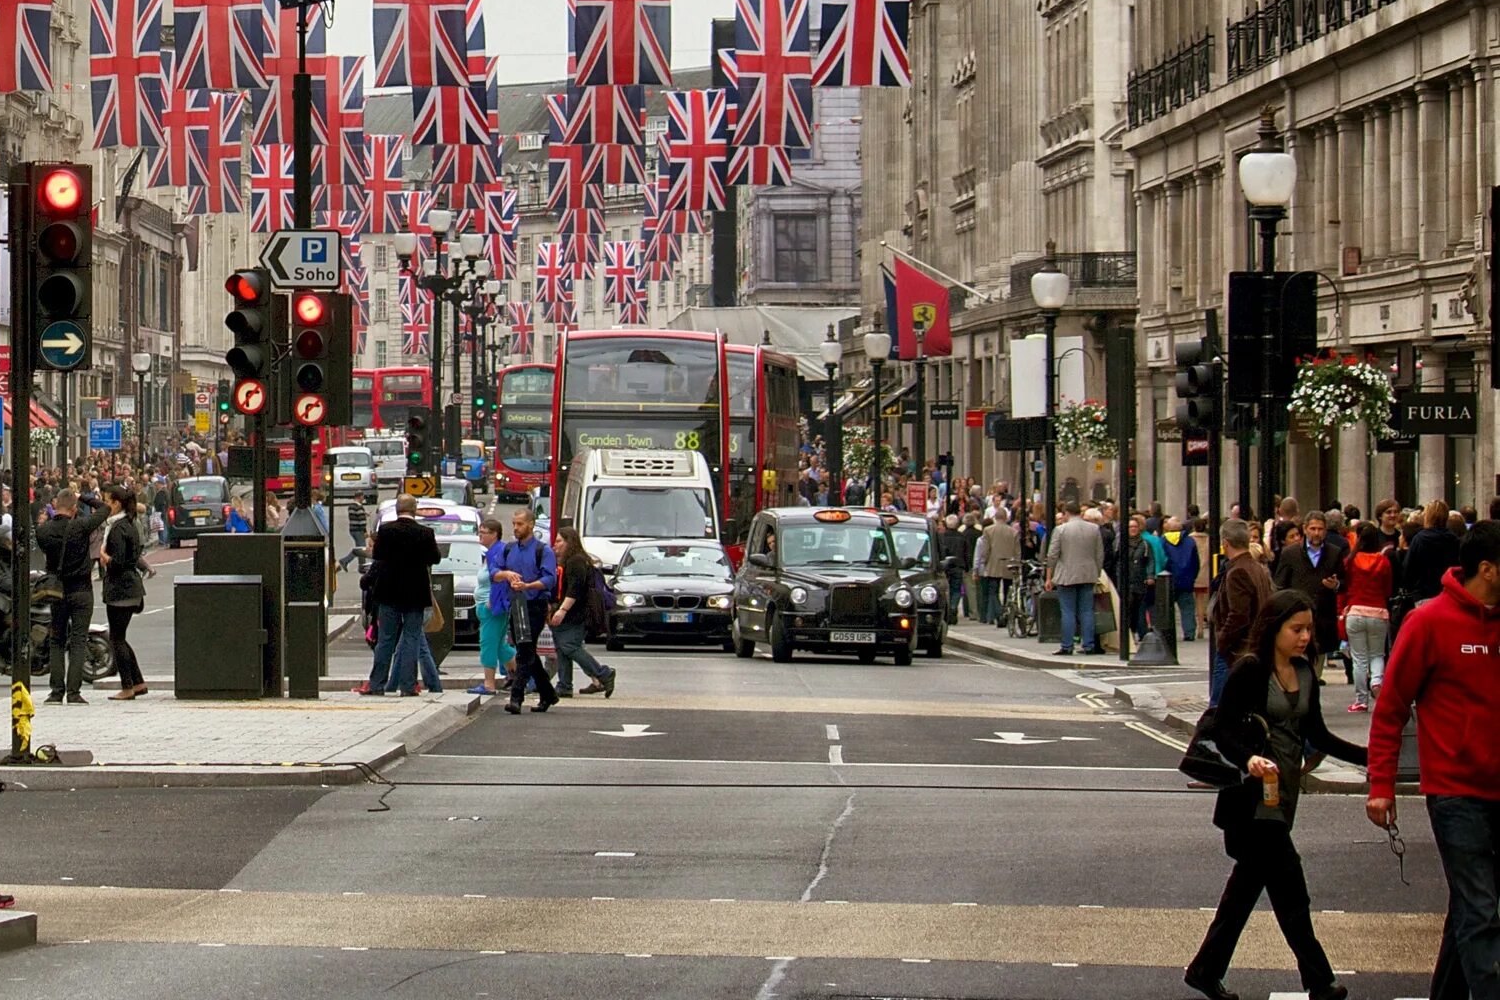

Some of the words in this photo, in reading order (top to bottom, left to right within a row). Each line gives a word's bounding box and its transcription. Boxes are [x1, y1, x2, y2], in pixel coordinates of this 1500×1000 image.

[293, 267, 336, 281] Soho
[1407, 406, 1472, 420] FURLA
[578, 433, 622, 446] Camden
[626, 433, 653, 446] Town
[674, 431, 699, 450] 88
